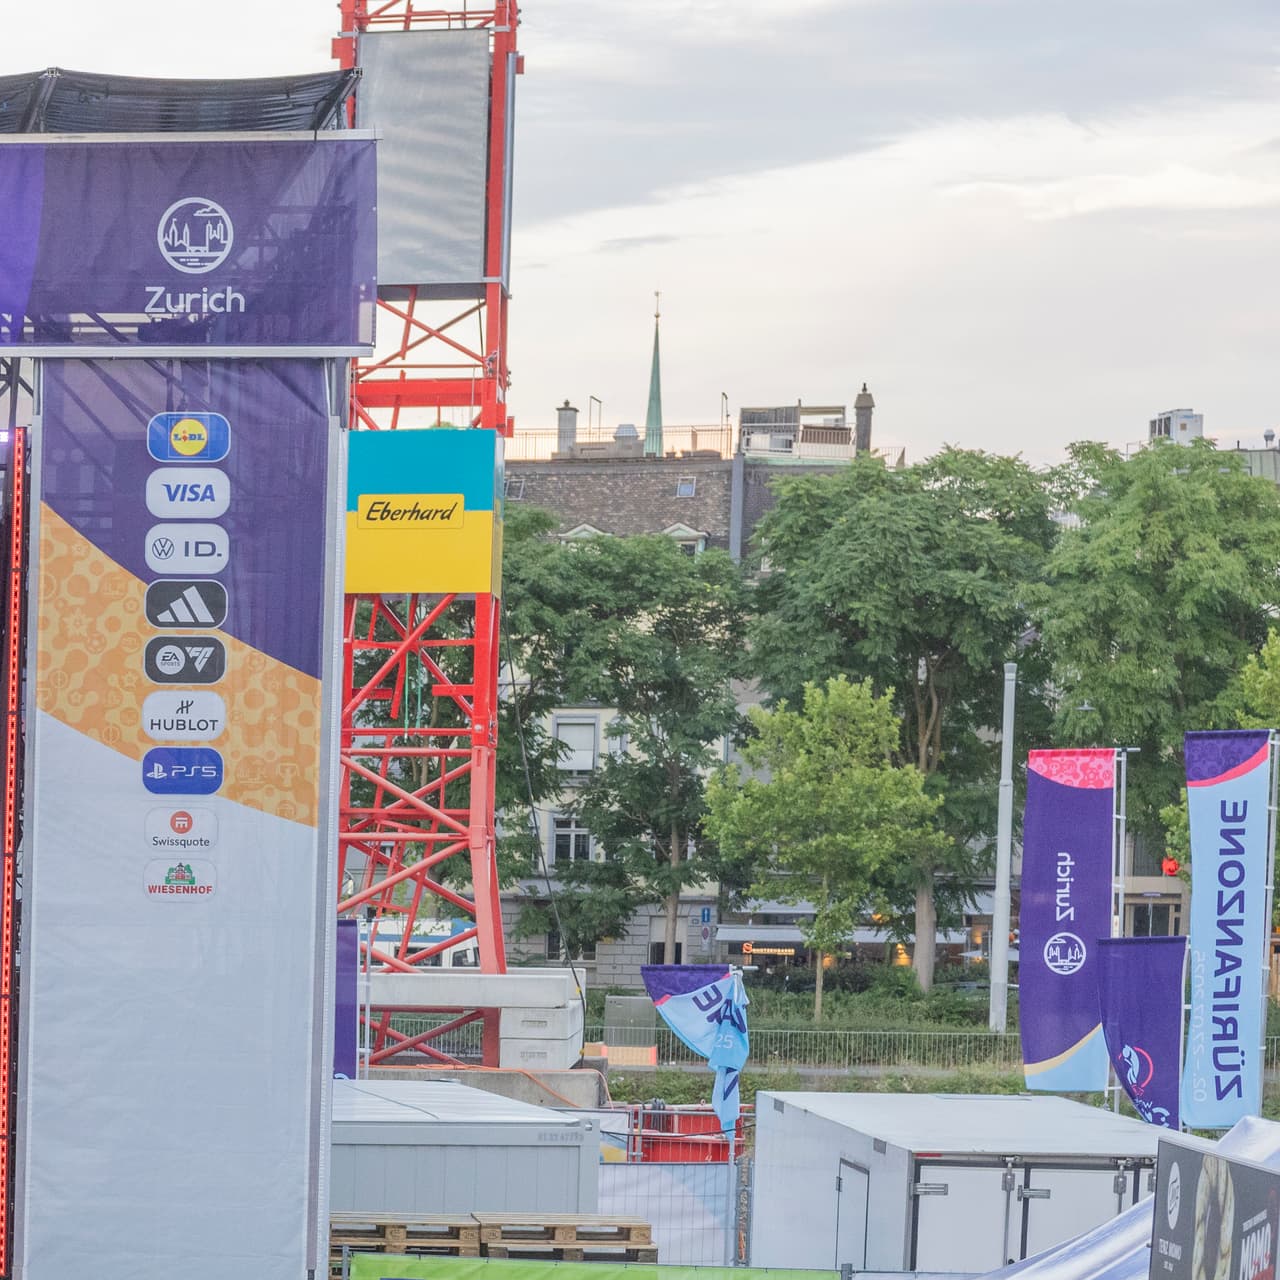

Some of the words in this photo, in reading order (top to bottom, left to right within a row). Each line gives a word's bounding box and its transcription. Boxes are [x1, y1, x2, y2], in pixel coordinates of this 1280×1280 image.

[144, 286, 246, 313] Zurich
[161, 483, 216, 502] VISA
[366, 501, 458, 521] Eberhard
[150, 719, 218, 731] HUBLOT
[171, 766, 217, 777] PS5
[152, 836, 210, 847] Swissquote
[148, 884, 212, 894] WIESENHOF
